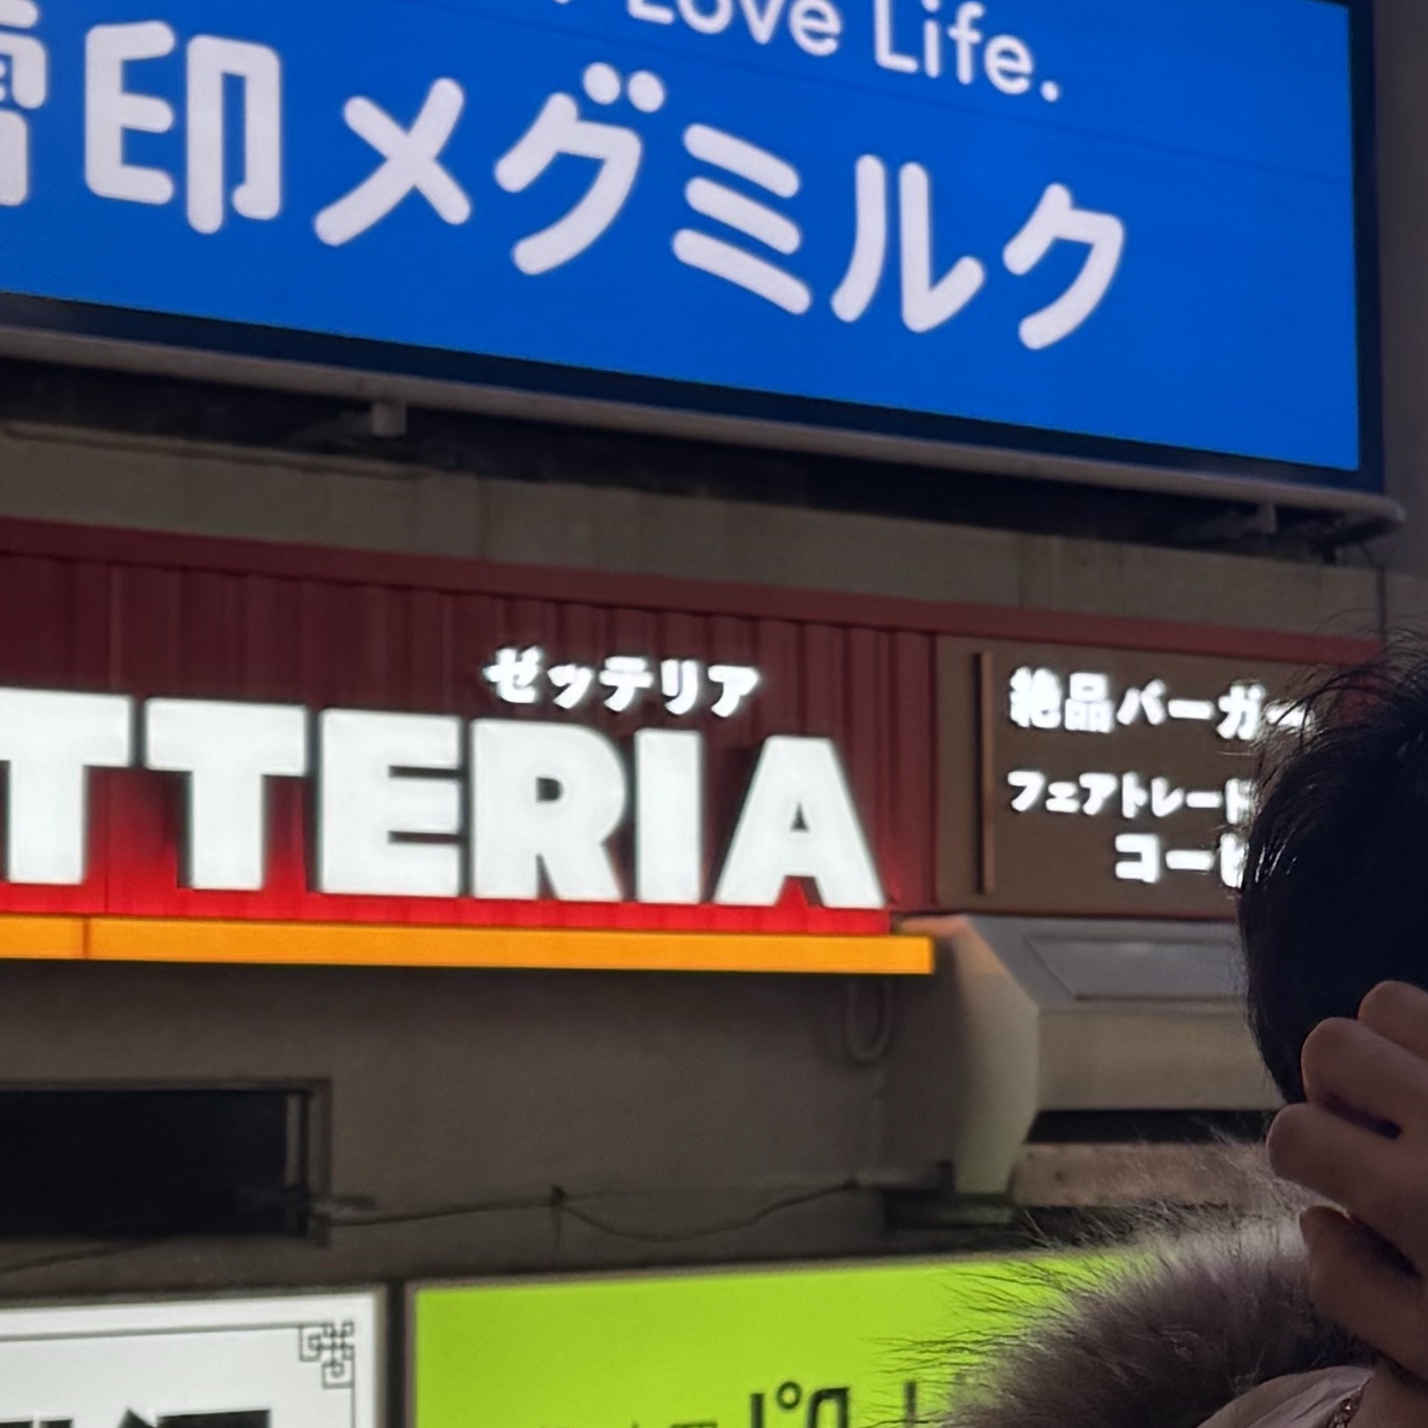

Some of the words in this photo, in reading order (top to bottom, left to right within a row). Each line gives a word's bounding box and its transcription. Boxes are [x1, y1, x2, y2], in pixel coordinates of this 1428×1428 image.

[482, 645, 761, 718] ゼッテリア
